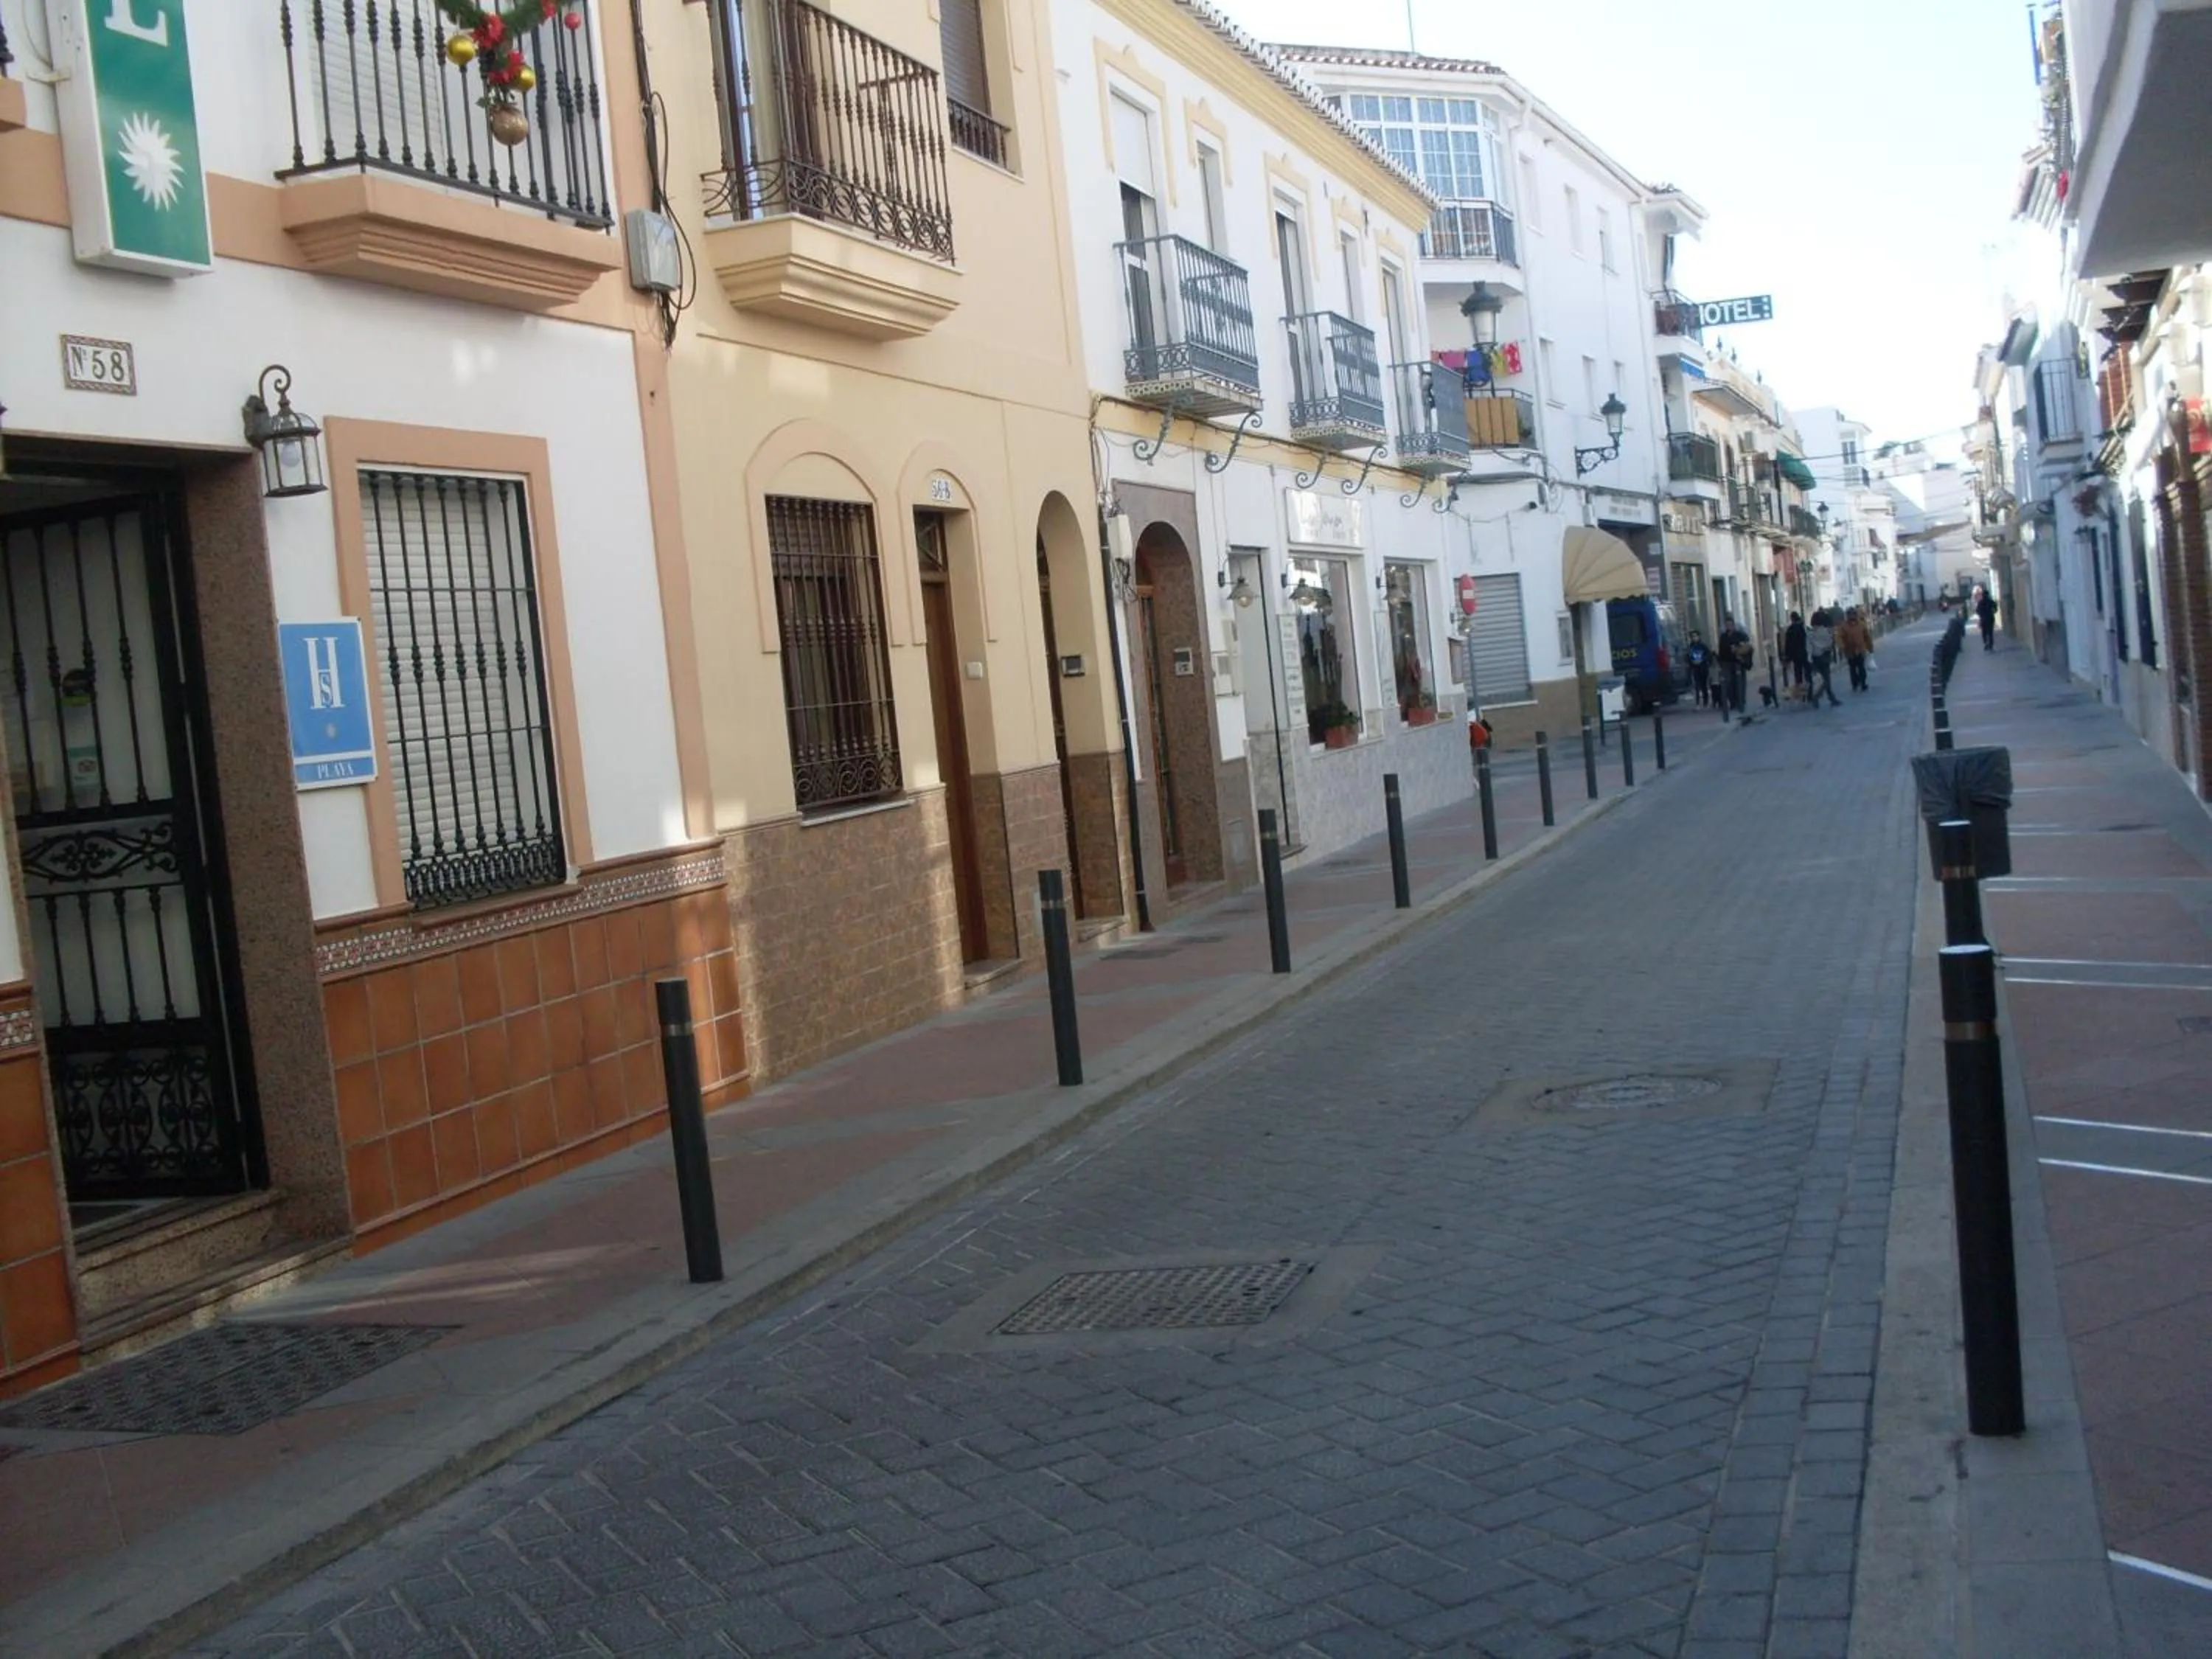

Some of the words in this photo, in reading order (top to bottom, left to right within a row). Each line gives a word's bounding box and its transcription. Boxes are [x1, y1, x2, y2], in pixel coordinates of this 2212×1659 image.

[1699, 299, 1761, 325] OTEL
[92, 350, 125, 381] 58
[317, 761, 355, 779] PLAYA
